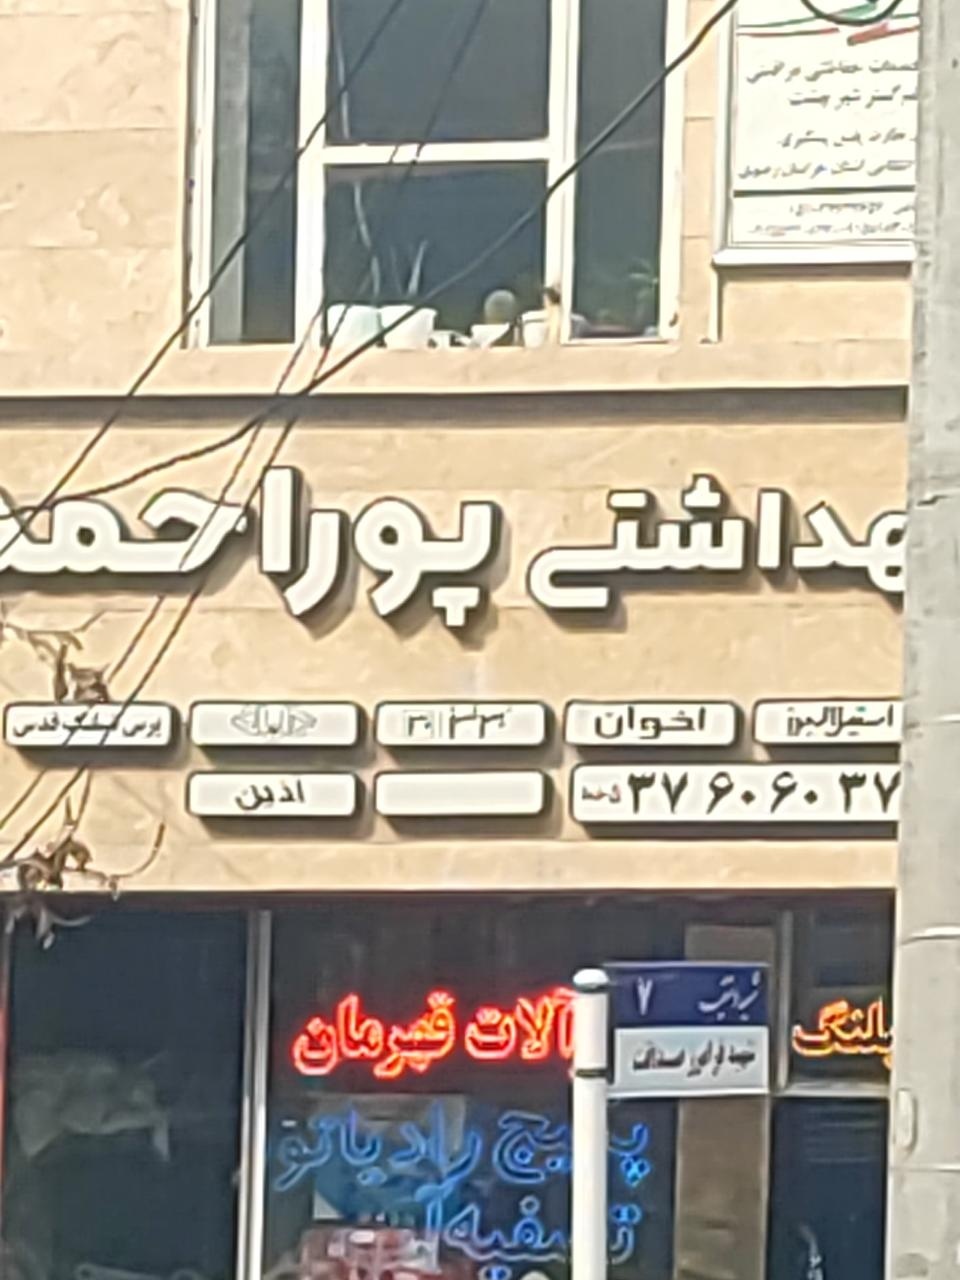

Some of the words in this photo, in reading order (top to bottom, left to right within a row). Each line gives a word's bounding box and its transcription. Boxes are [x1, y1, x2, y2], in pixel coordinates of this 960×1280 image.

[529, 473, 908, 610] هداشتی
[593, 705, 707, 740] اخوان
[635, 975, 654, 1016] ۷
[293, 990, 456, 1079] قهرمان
